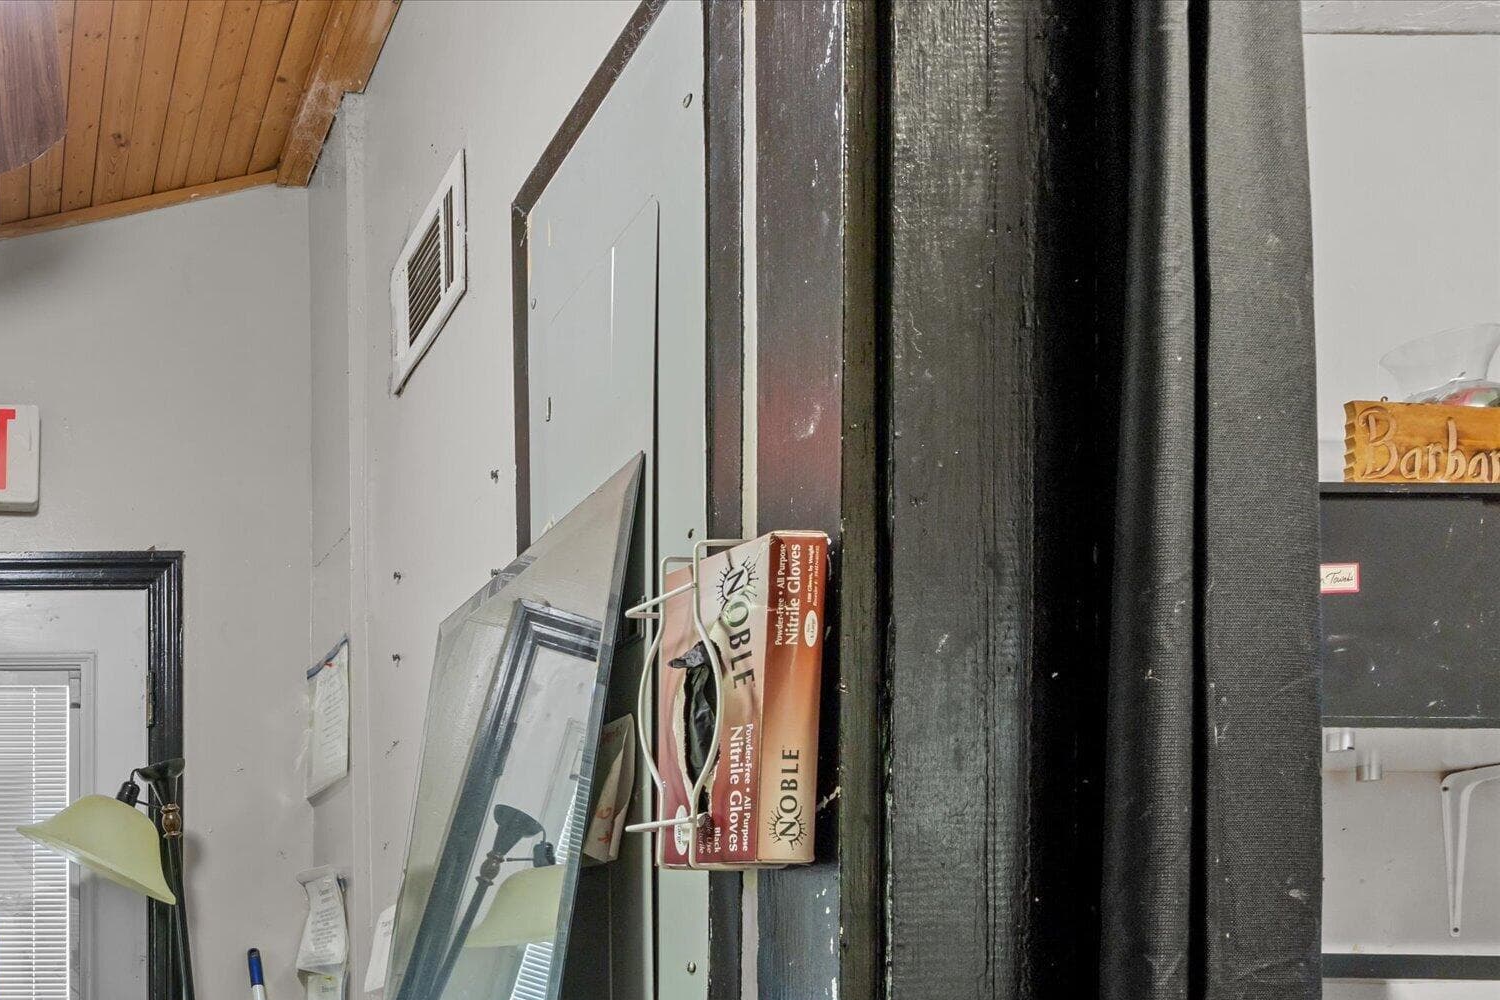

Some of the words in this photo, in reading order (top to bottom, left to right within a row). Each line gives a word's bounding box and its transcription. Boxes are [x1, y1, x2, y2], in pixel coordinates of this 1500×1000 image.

[776, 577, 785, 589] All
[777, 543, 788, 576] Purpose
[787, 544, 802, 594] Gloves
[724, 568, 756, 690] NOBLE
[785, 598, 800, 645] Nitrile
[729, 725, 744, 785] Nitrile
[744, 723, 754, 785] Powder-Free
[743, 796, 752, 810] All
[779, 749, 800, 838] NOBLE
[714, 826, 722, 853] Black
[728, 790, 743, 852] Gloves
[741, 812, 751, 852] Purpose
